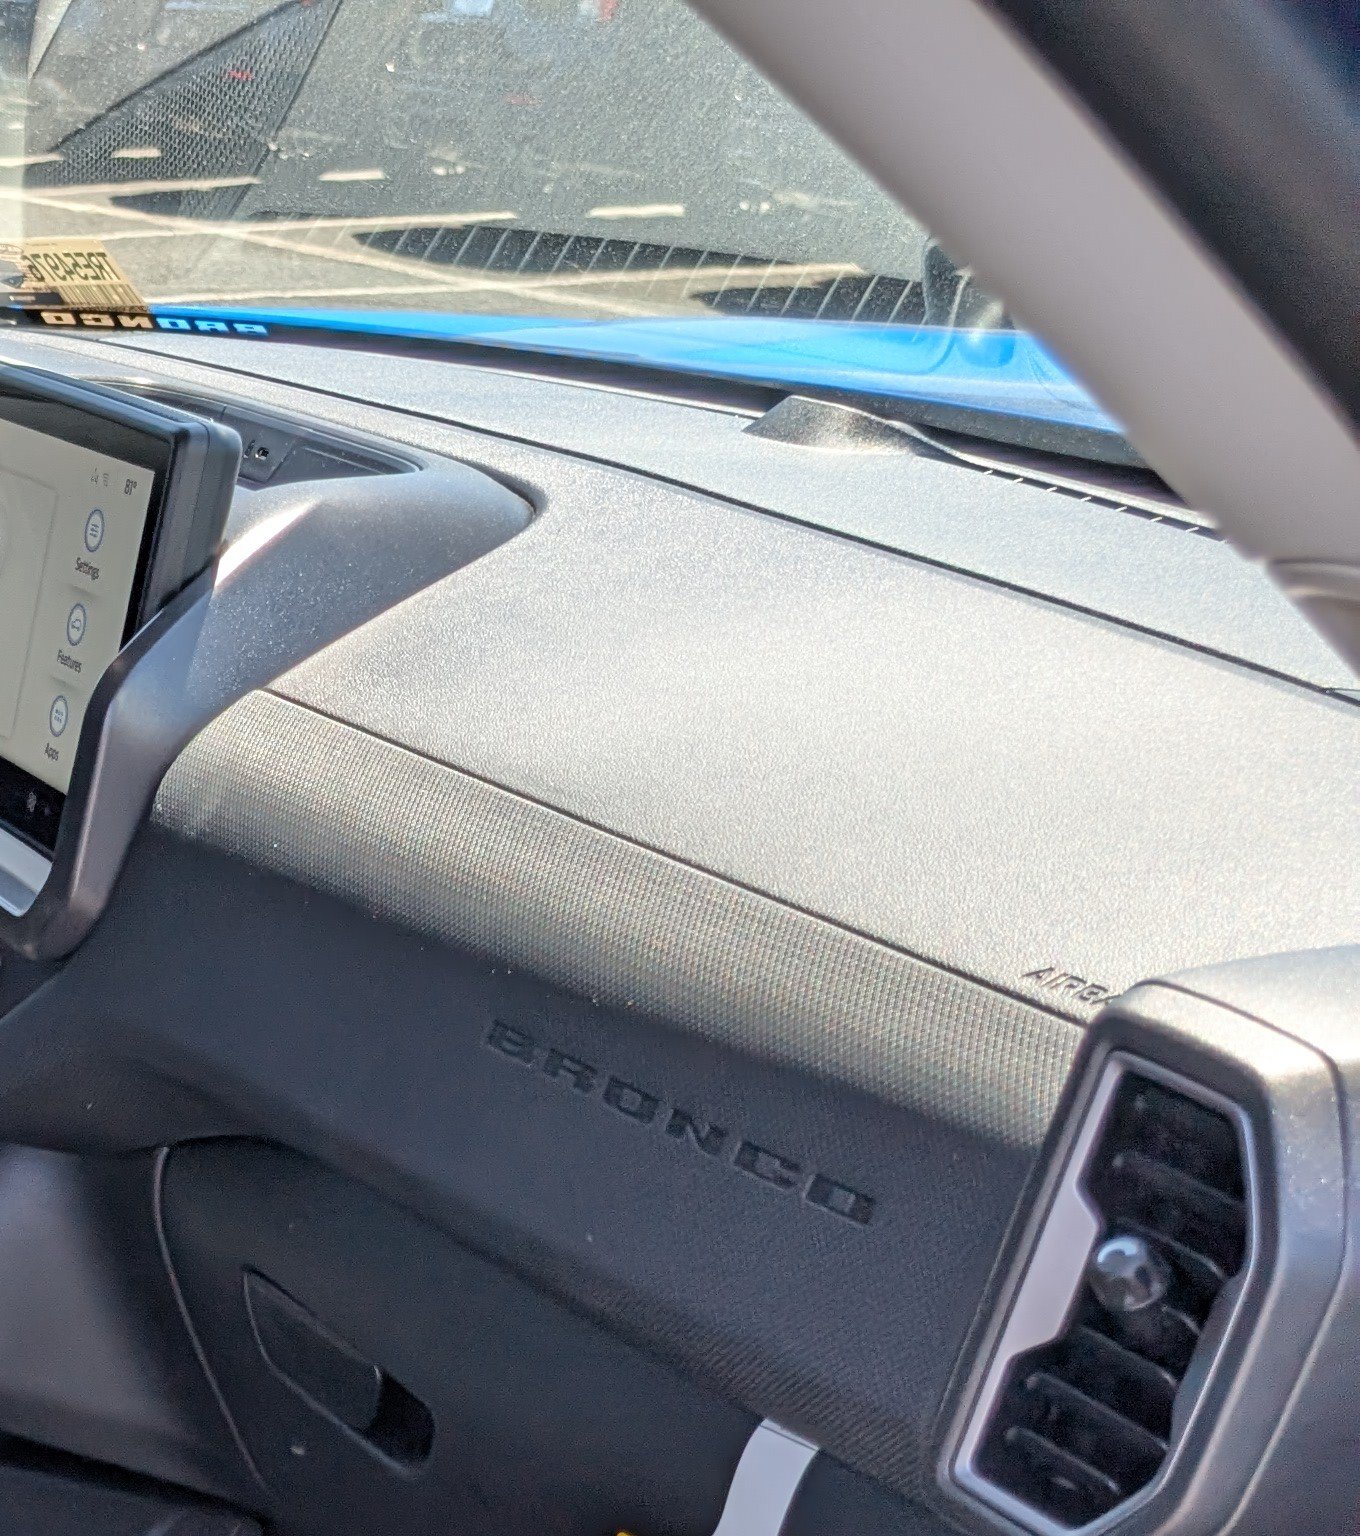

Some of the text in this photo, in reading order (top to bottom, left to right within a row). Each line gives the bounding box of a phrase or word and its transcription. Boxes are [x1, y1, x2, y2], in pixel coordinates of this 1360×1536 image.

[75, 557, 100, 581] Settings
[57, 649, 82, 673] Features
[44, 742, 59, 762] Apps
[483, 1019, 877, 1226] BRONCO
